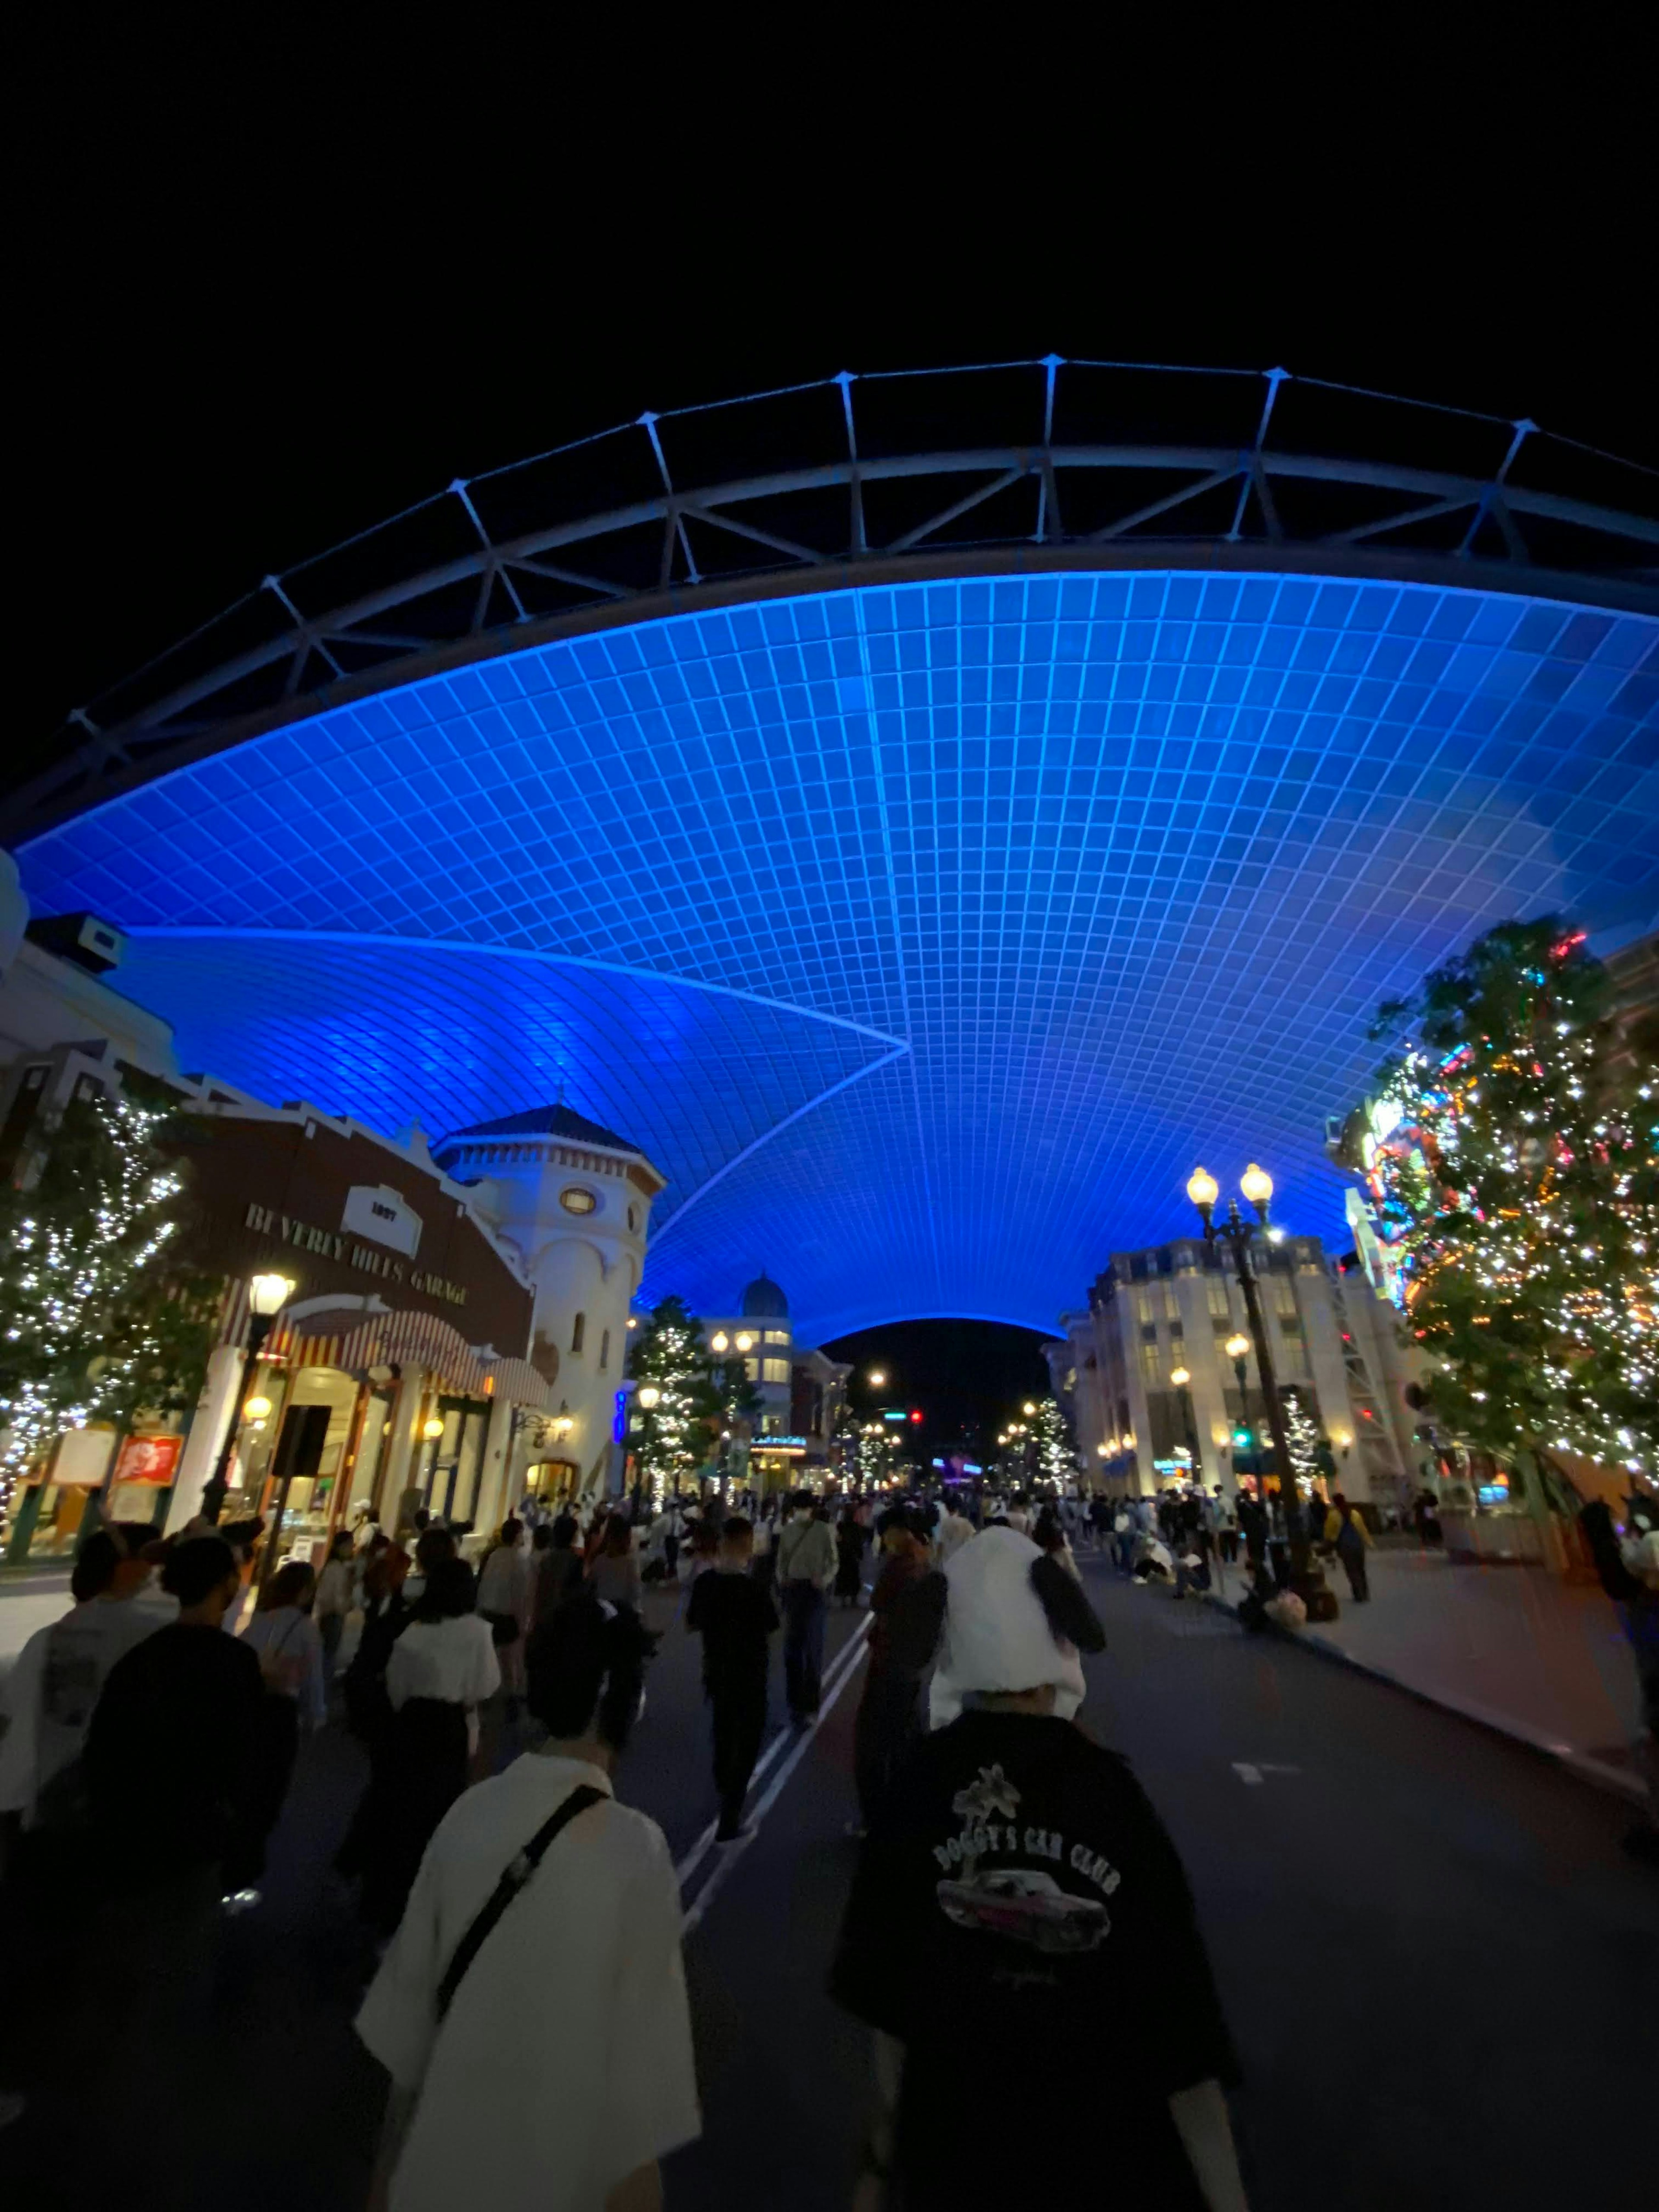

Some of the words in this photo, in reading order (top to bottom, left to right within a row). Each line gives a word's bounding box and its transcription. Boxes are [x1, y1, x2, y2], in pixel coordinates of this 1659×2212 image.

[245, 1202, 347, 1260] BEVERLY
[351, 1244, 404, 1284] HILLS
[410, 1269, 469, 1305] GARAGE
[1071, 1844, 1121, 1895] CLUB
